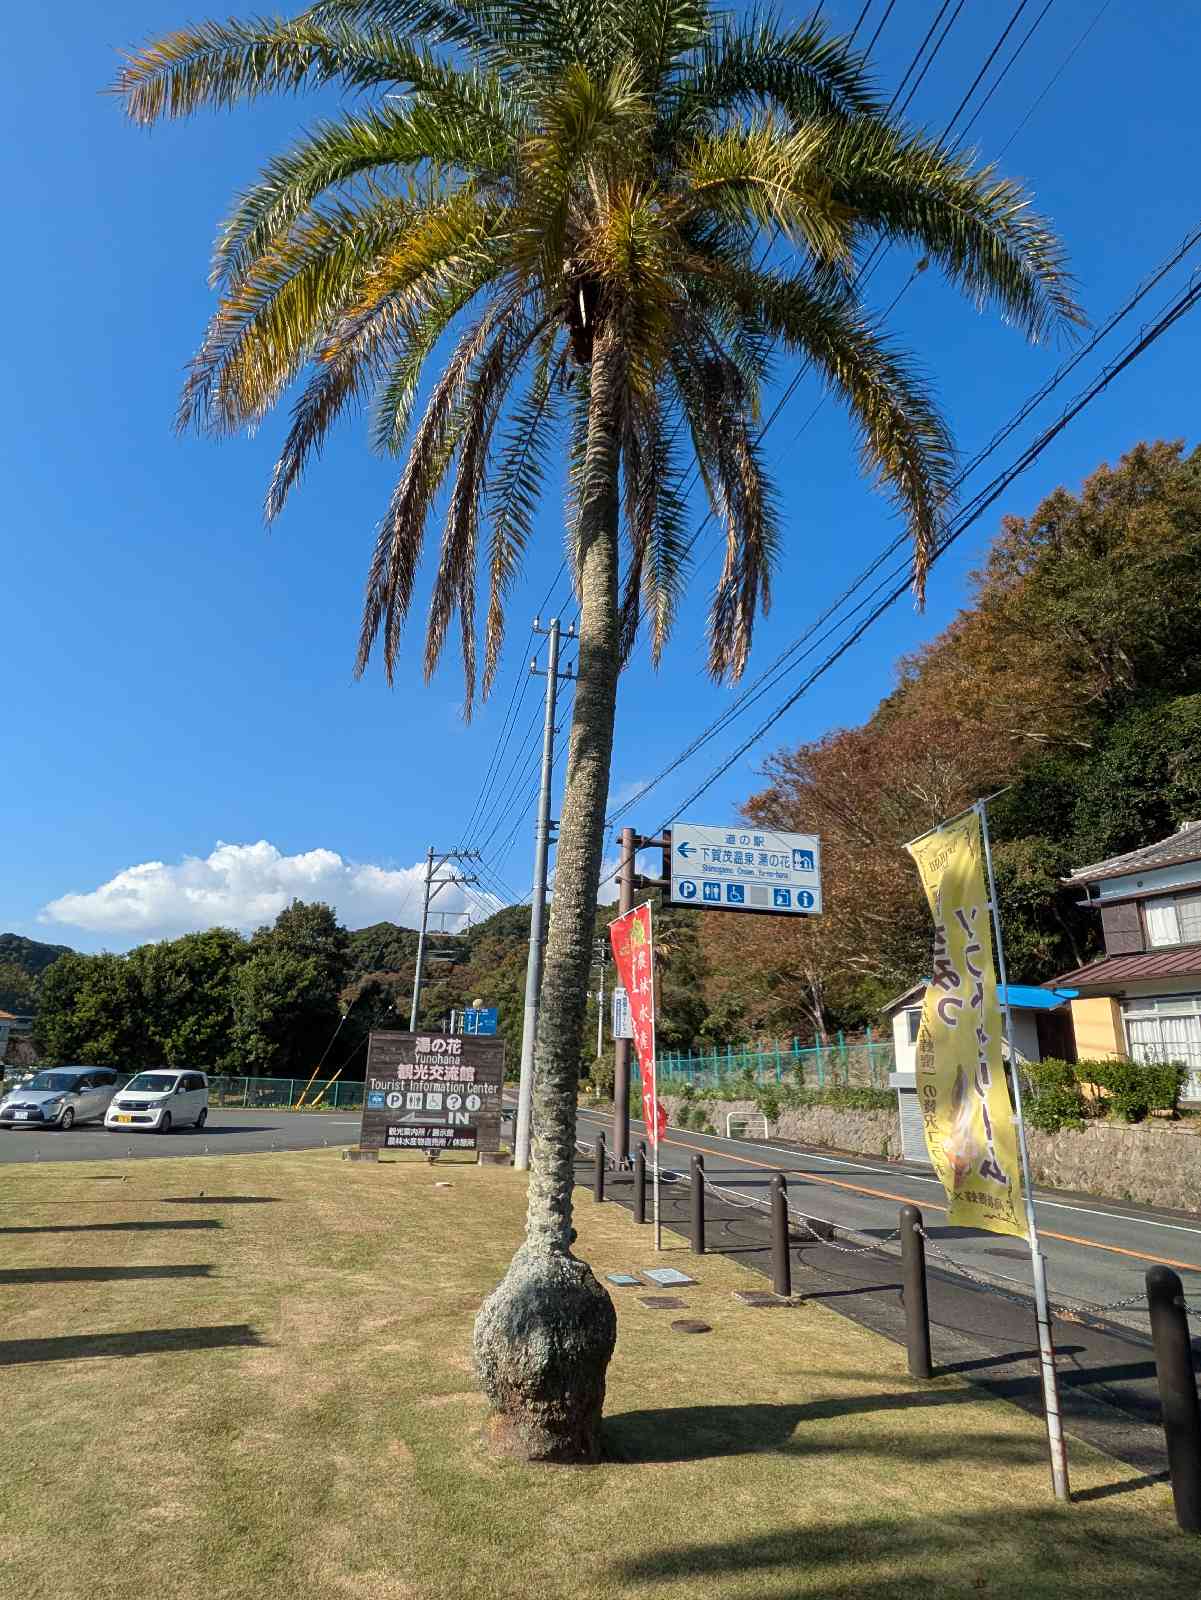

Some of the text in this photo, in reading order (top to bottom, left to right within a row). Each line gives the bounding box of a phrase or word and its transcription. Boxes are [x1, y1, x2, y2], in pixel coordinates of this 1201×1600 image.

[726, 833, 765, 847] 道の駅
[702, 848, 791, 868] 下賀茂温泉 湯の花
[415, 1037, 462, 1054] 湯の花
[415, 1053, 460, 1065] Yunohana
[397, 1064, 475, 1081] 観光交流館
[370, 1078, 499, 1094] Tourist Information Center
[448, 1111, 470, 1125] IN
